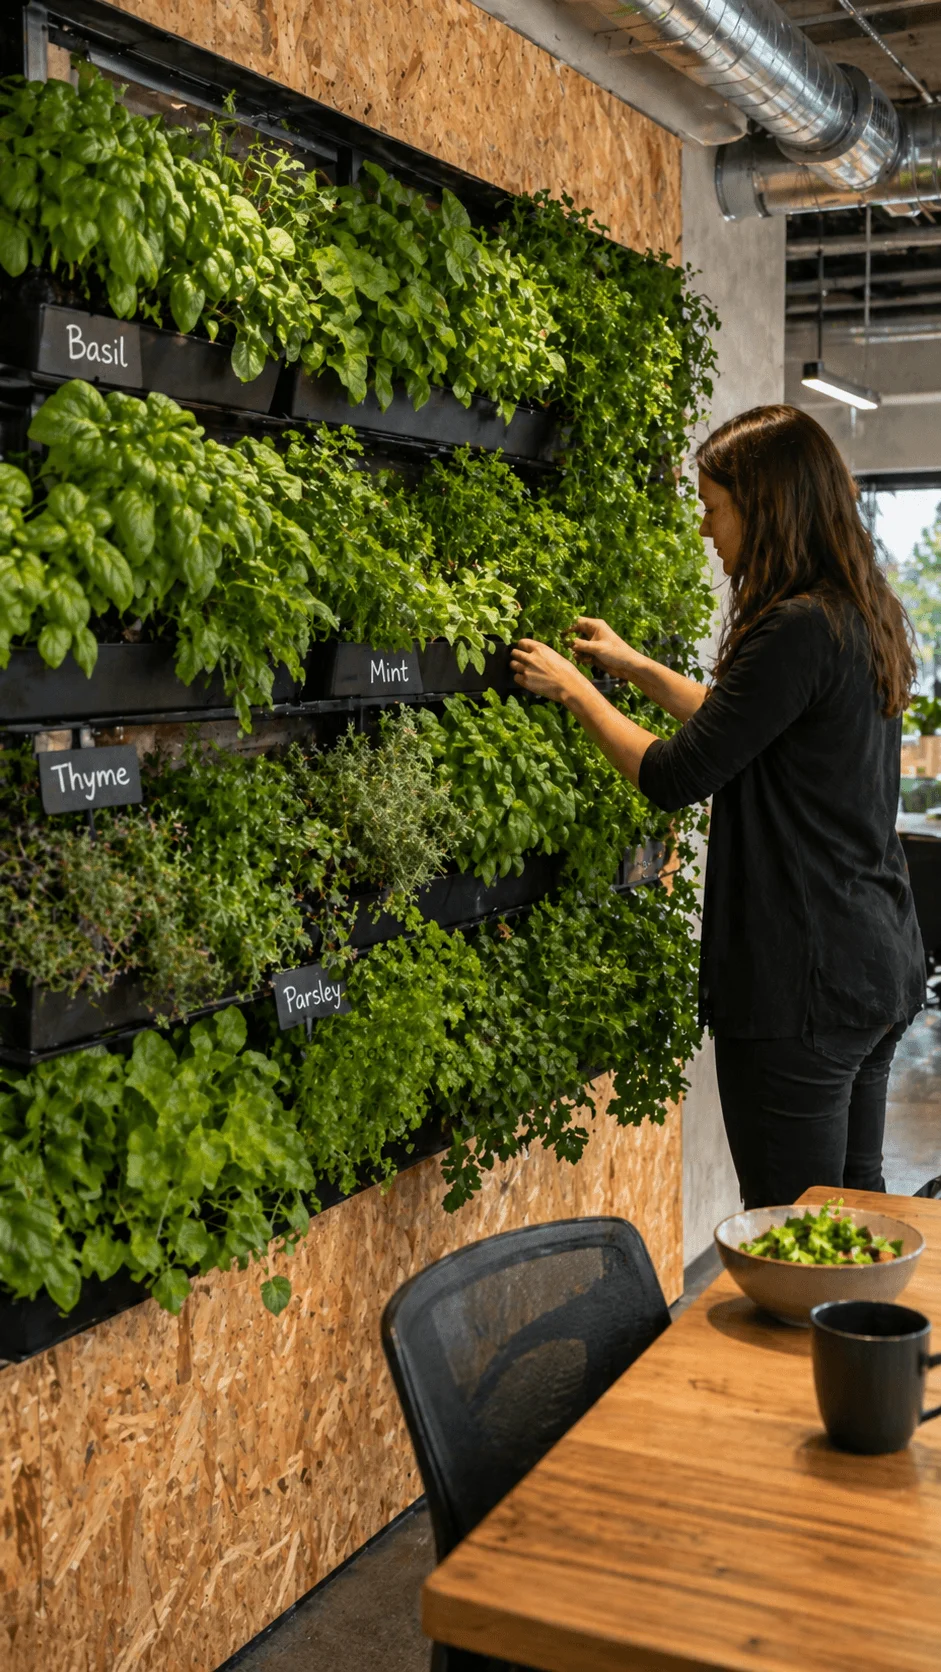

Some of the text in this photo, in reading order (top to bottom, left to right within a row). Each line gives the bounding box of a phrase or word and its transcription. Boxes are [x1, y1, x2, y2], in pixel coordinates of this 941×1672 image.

[65, 323, 129, 368] Basil
[370, 659, 409, 684] Mint
[50, 762, 131, 801] Thyme
[282, 980, 342, 1014] Parsley
